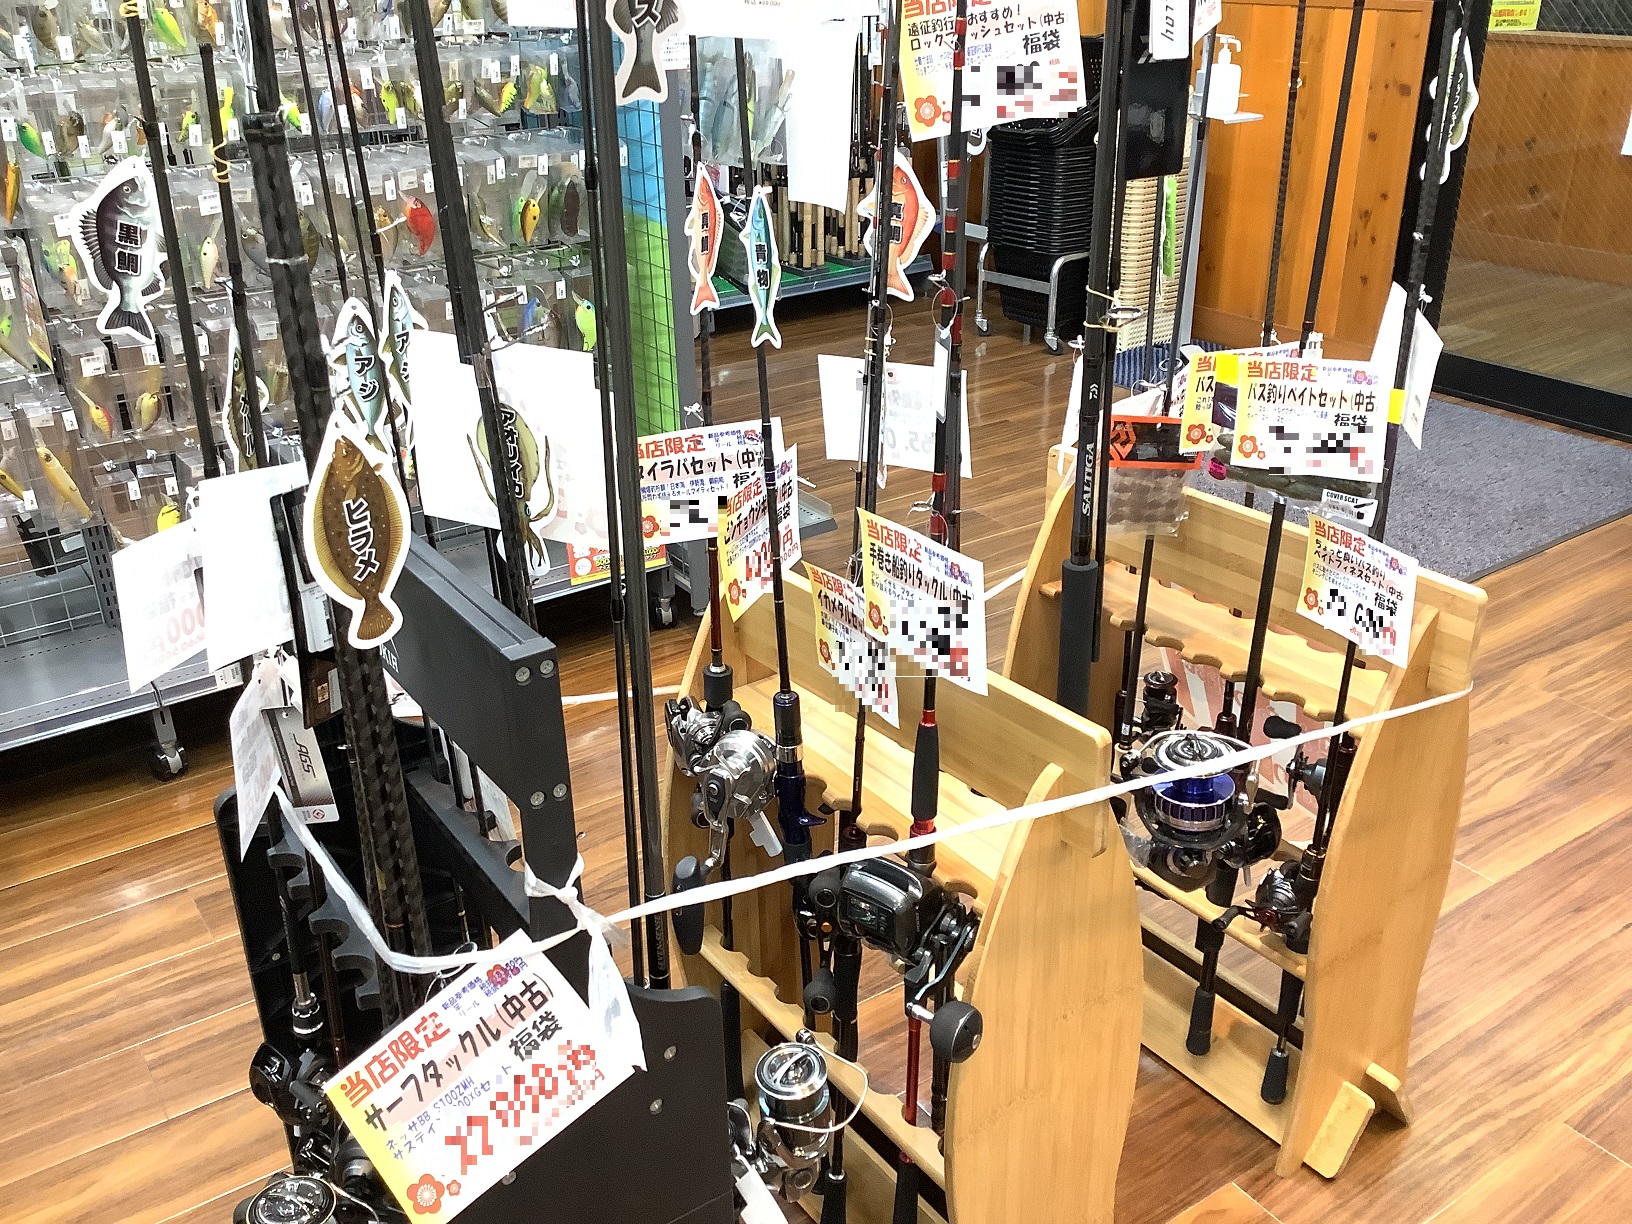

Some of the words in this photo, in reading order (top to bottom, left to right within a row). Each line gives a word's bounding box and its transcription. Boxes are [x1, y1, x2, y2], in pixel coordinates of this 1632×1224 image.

[1022, 29, 1060, 55] 福袋
[115, 219, 142, 276] 黒鯛
[755, 242, 770, 289] 青物
[353, 355, 379, 402] アジ
[1247, 361, 1318, 383] 当店限定
[1334, 412, 1368, 427] 福袋
[1082, 442, 1095, 517] SALTIGA
[342, 497, 380, 582] ヒラメ
[866, 518, 922, 564] 当店限定
[1314, 520, 1367, 557] 当店限定
[1315, 538, 1386, 581] ちょっと良いバス釣り
[811, 567, 855, 605] 当店限定
[1374, 592, 1398, 617] 福袋
[293, 734, 316, 779] AGS
[340, 1012, 451, 1107] 当店限定
[364, 973, 555, 1132] サーフタックル(中古)
[508, 1011, 564, 1063] 福袋
